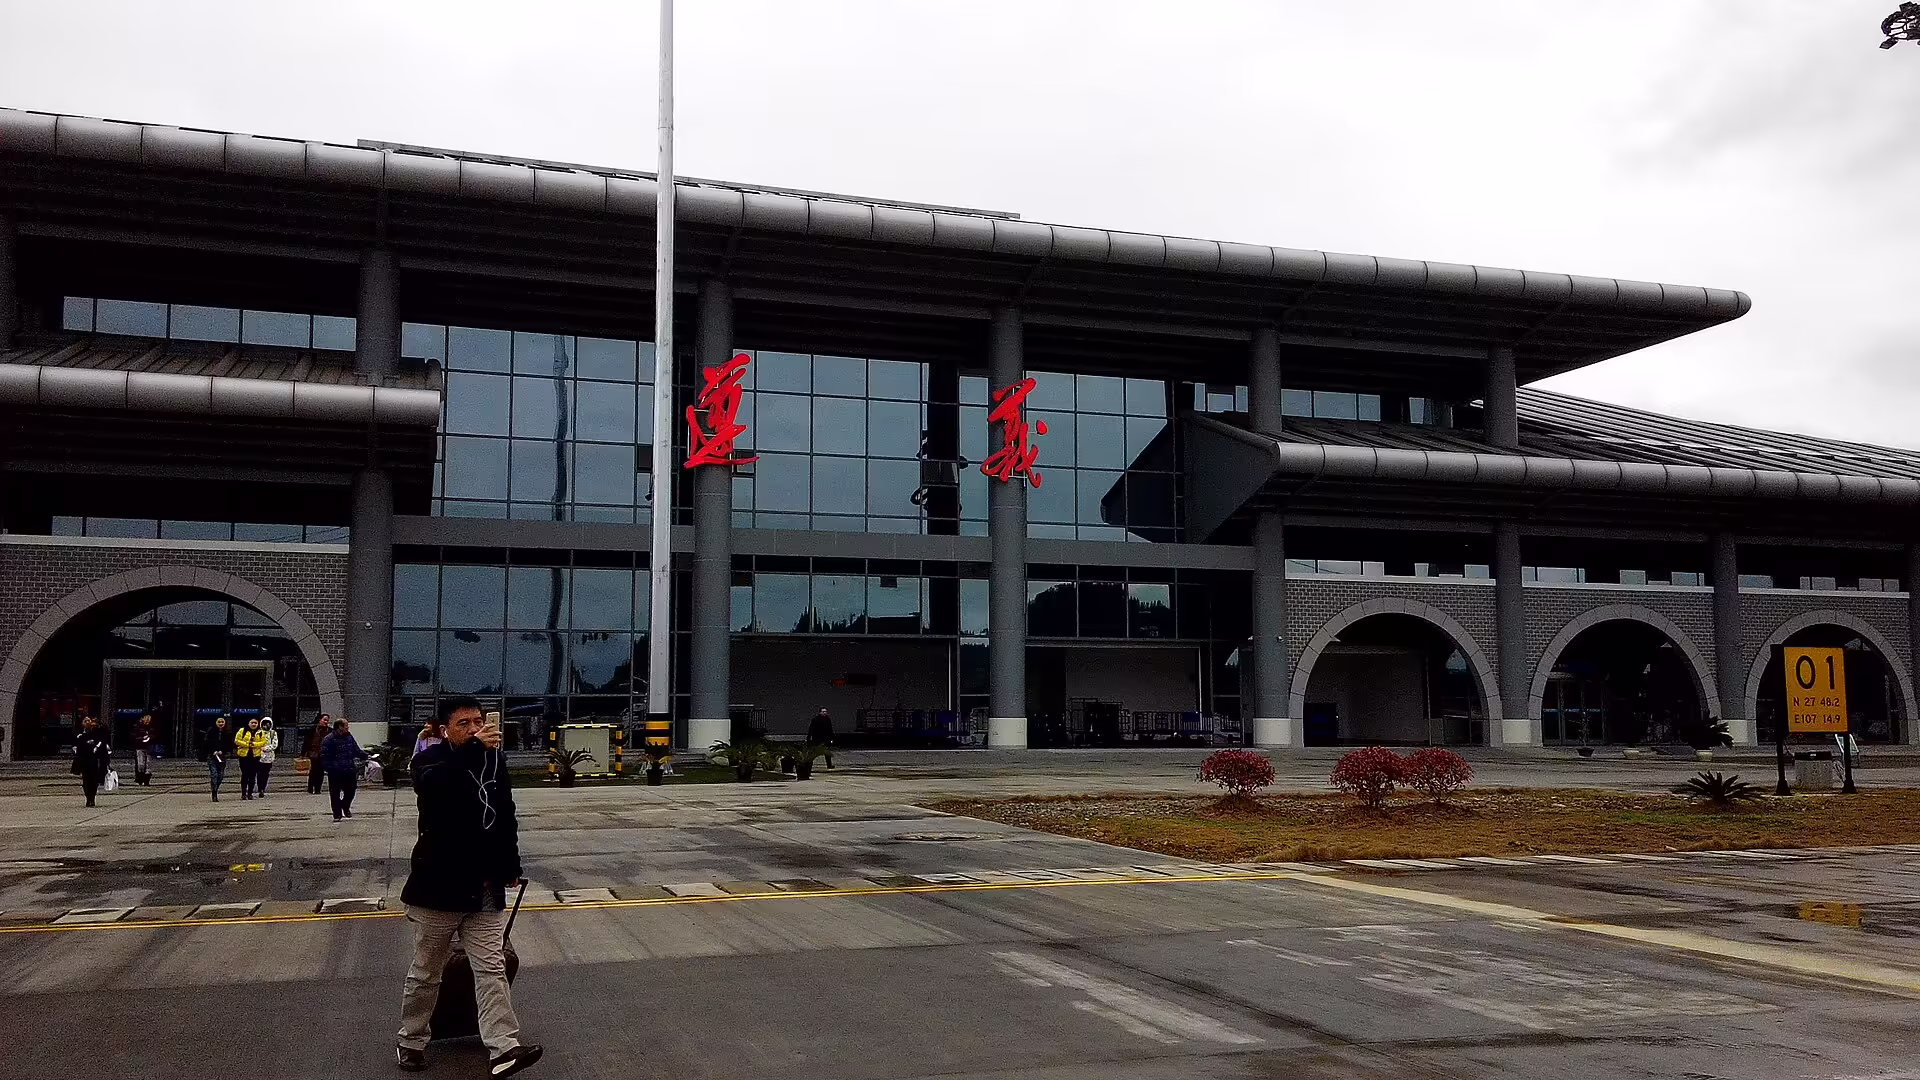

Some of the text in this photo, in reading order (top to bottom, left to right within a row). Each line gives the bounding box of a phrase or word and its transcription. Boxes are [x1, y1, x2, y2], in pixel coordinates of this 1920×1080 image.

[1796, 655, 1835, 690] 01
[1793, 697, 1840, 707] N 27 48.2
[1823, 714, 1841, 724] 14.9
